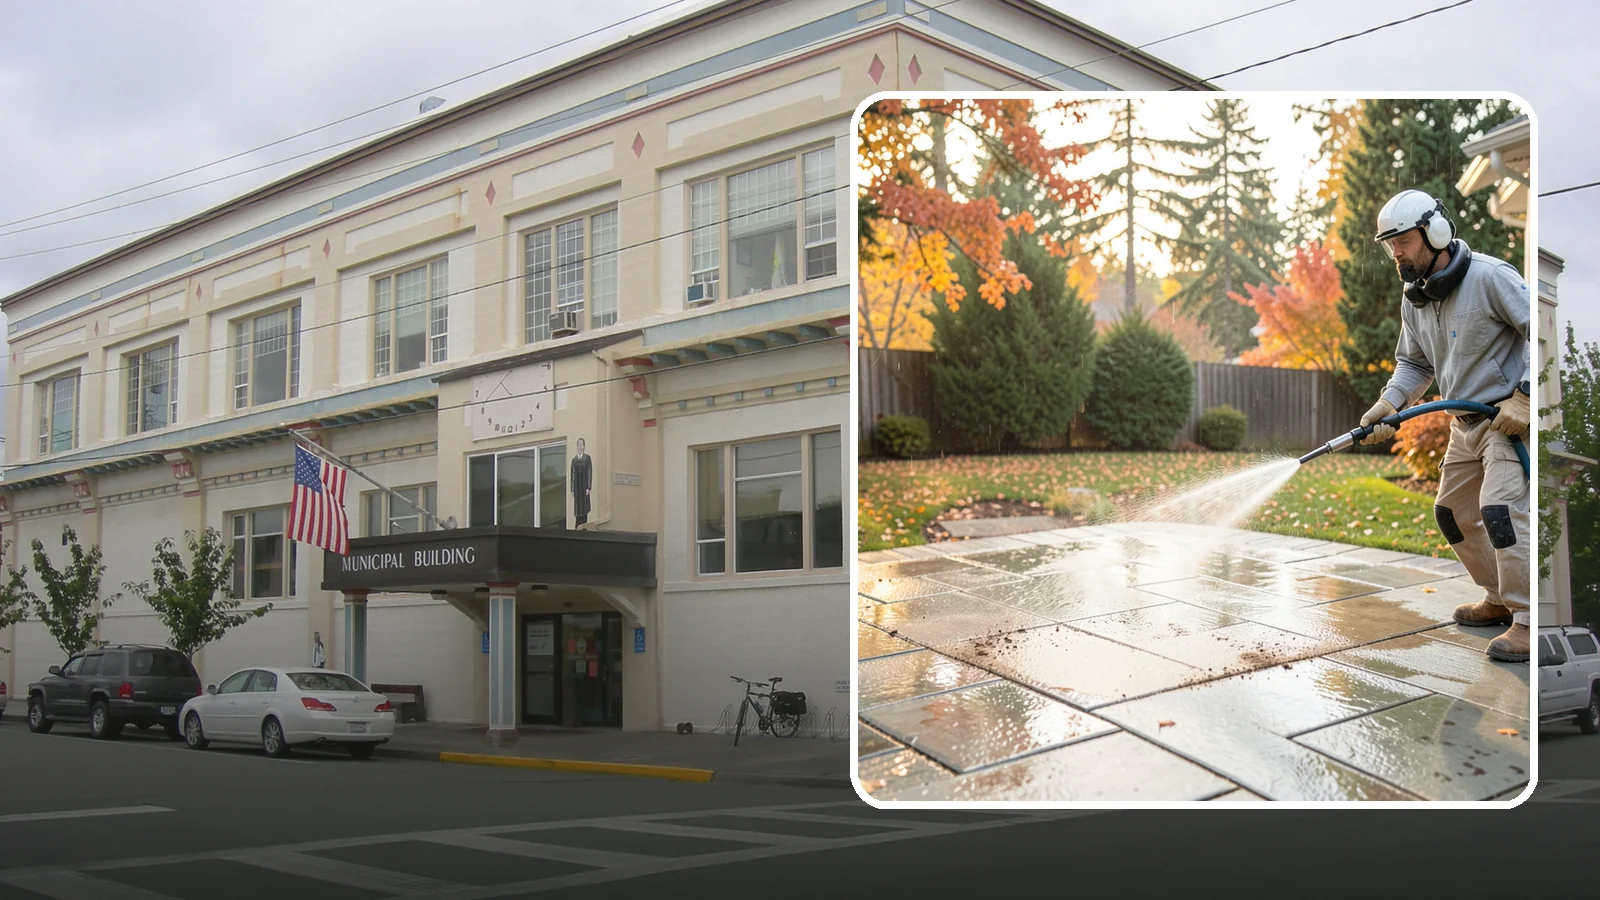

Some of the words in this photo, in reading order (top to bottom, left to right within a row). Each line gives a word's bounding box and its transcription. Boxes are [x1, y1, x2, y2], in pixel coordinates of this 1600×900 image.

[480, 406, 485, 415] 8
[487, 417, 492, 426] 9
[529, 413, 533, 422] 3
[494, 423, 500, 431] 10
[521, 420, 525, 428] 2
[507, 425, 513, 433] 12
[342, 552, 405, 571] MUNICIPAL
[414, 546, 475, 567] BUILDING
